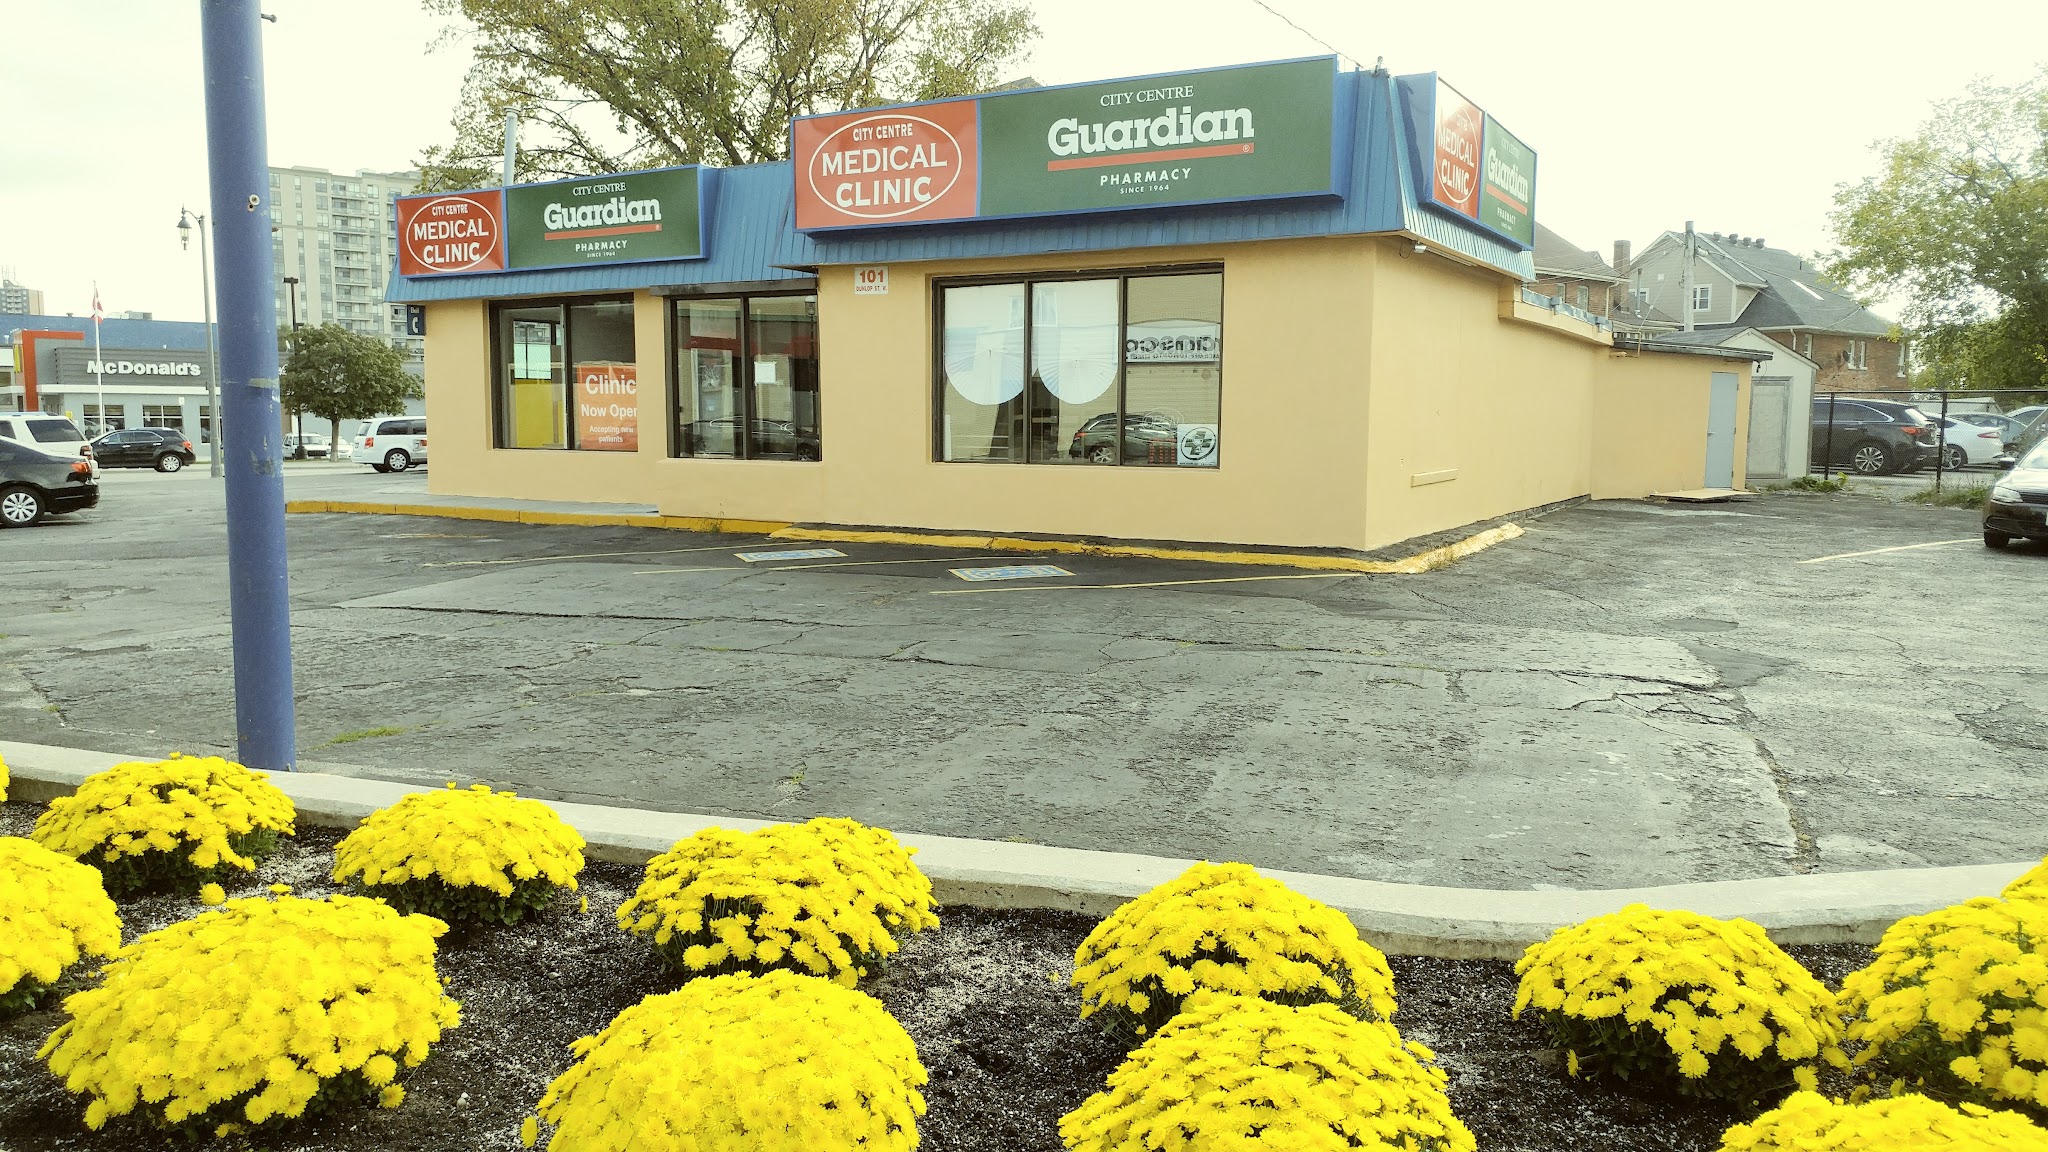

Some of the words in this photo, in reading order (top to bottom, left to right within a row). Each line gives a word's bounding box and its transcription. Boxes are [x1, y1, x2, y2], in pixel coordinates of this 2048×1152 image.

[1100, 92, 1134, 107] CITY
[1136, 85, 1194, 101] CENTRE
[853, 127, 874, 142] CITY
[876, 123, 913, 140] CENTRE
[1047, 105, 1255, 156] Guardian
[1438, 126, 1475, 168] MEDICAL
[821, 142, 948, 177] MEDICAL
[1100, 167, 1192, 186] PHARMACY
[1441, 158, 1470, 196] CLINIC
[1487, 147, 1528, 204] Guardian
[573, 185, 593, 197] CITY
[593, 182, 626, 194] CENTRE
[835, 176, 932, 208] CLINIC
[1120, 186, 1145, 195] SINCE
[1149, 184, 1170, 192] 1964
[432, 205, 445, 216] CITY
[445, 203, 469, 215] CENTRE
[543, 196, 662, 231] Guardian
[413, 218, 489, 241] MEDICAL
[423, 241, 480, 264] CLINIC
[575, 240, 628, 252] PHARMACY
[860, 270, 883, 283] 101
[86, 360, 201, 376] McDonald's
[586, 375, 636, 394] Clinic
[581, 404, 606, 416] Now
[590, 426, 619, 434] Accepting
[621, 426, 634, 434] new
